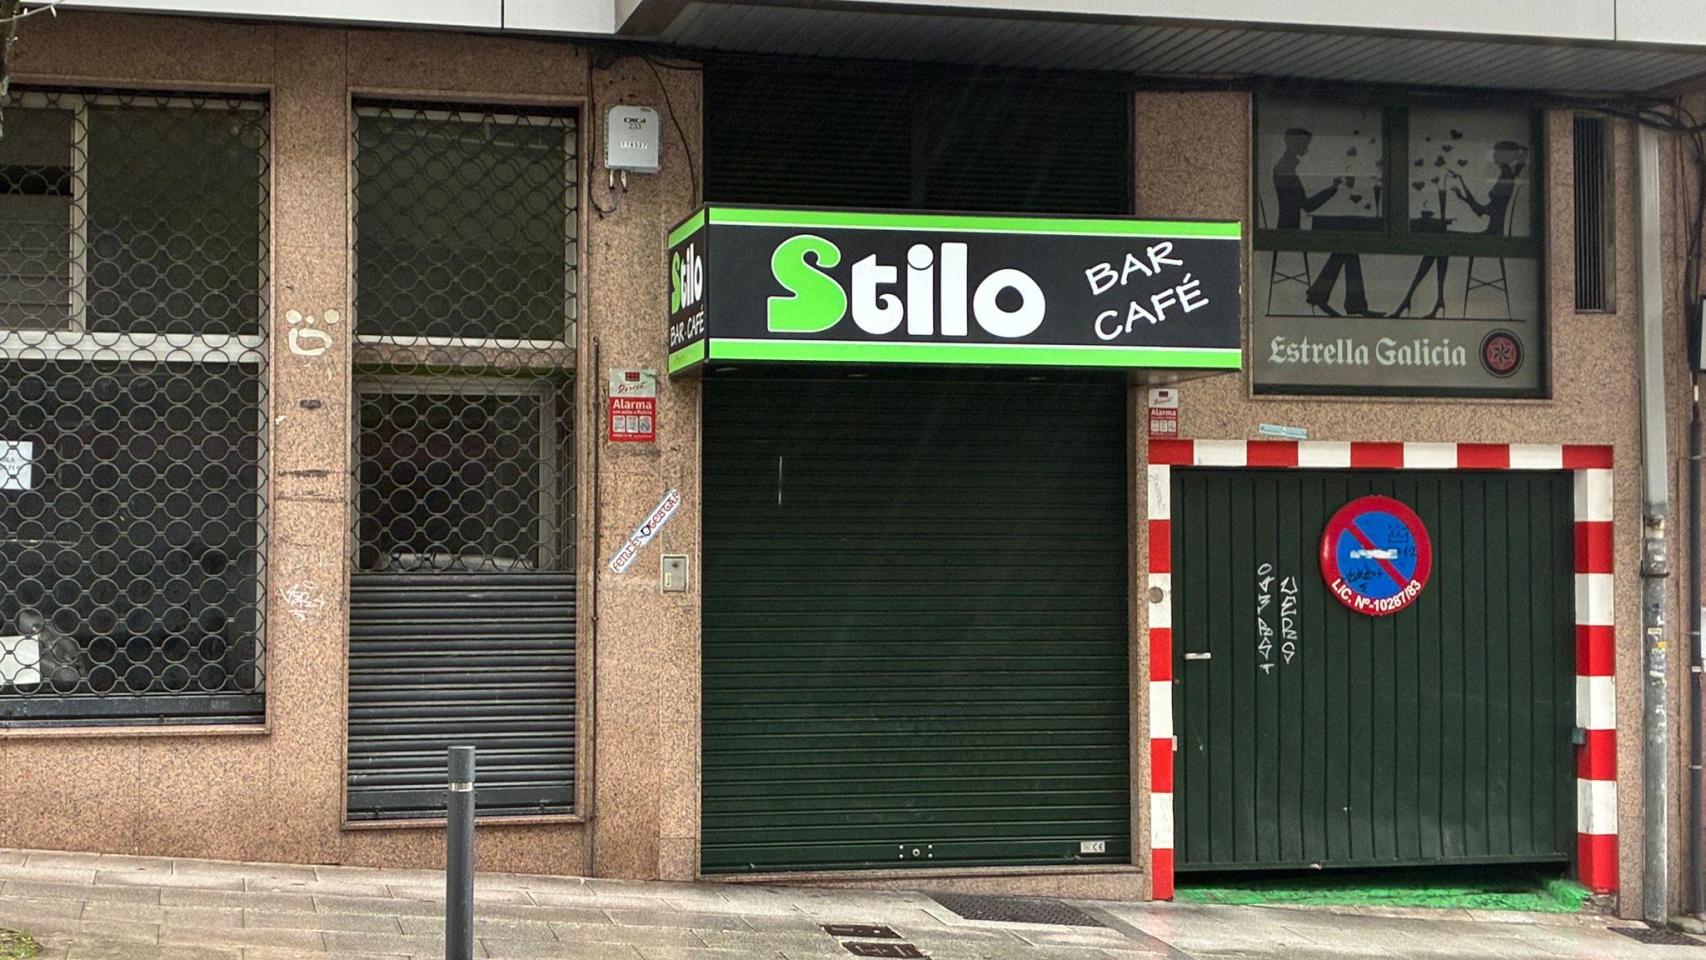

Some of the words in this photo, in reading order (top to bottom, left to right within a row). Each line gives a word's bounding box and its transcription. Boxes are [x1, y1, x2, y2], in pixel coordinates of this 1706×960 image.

[671, 242, 703, 315] Stilo
[767, 234, 1046, 338] Stilo
[1085, 241, 1183, 295] BAR
[1093, 273, 1209, 341] CAFÉ
[1268, 336, 1370, 366] Estrella
[1376, 337, 1467, 367] Galicia
[612, 398, 652, 410] Alarma
[1150, 408, 1177, 416] Alarma
[1331, 578, 1352, 604] LIC.
